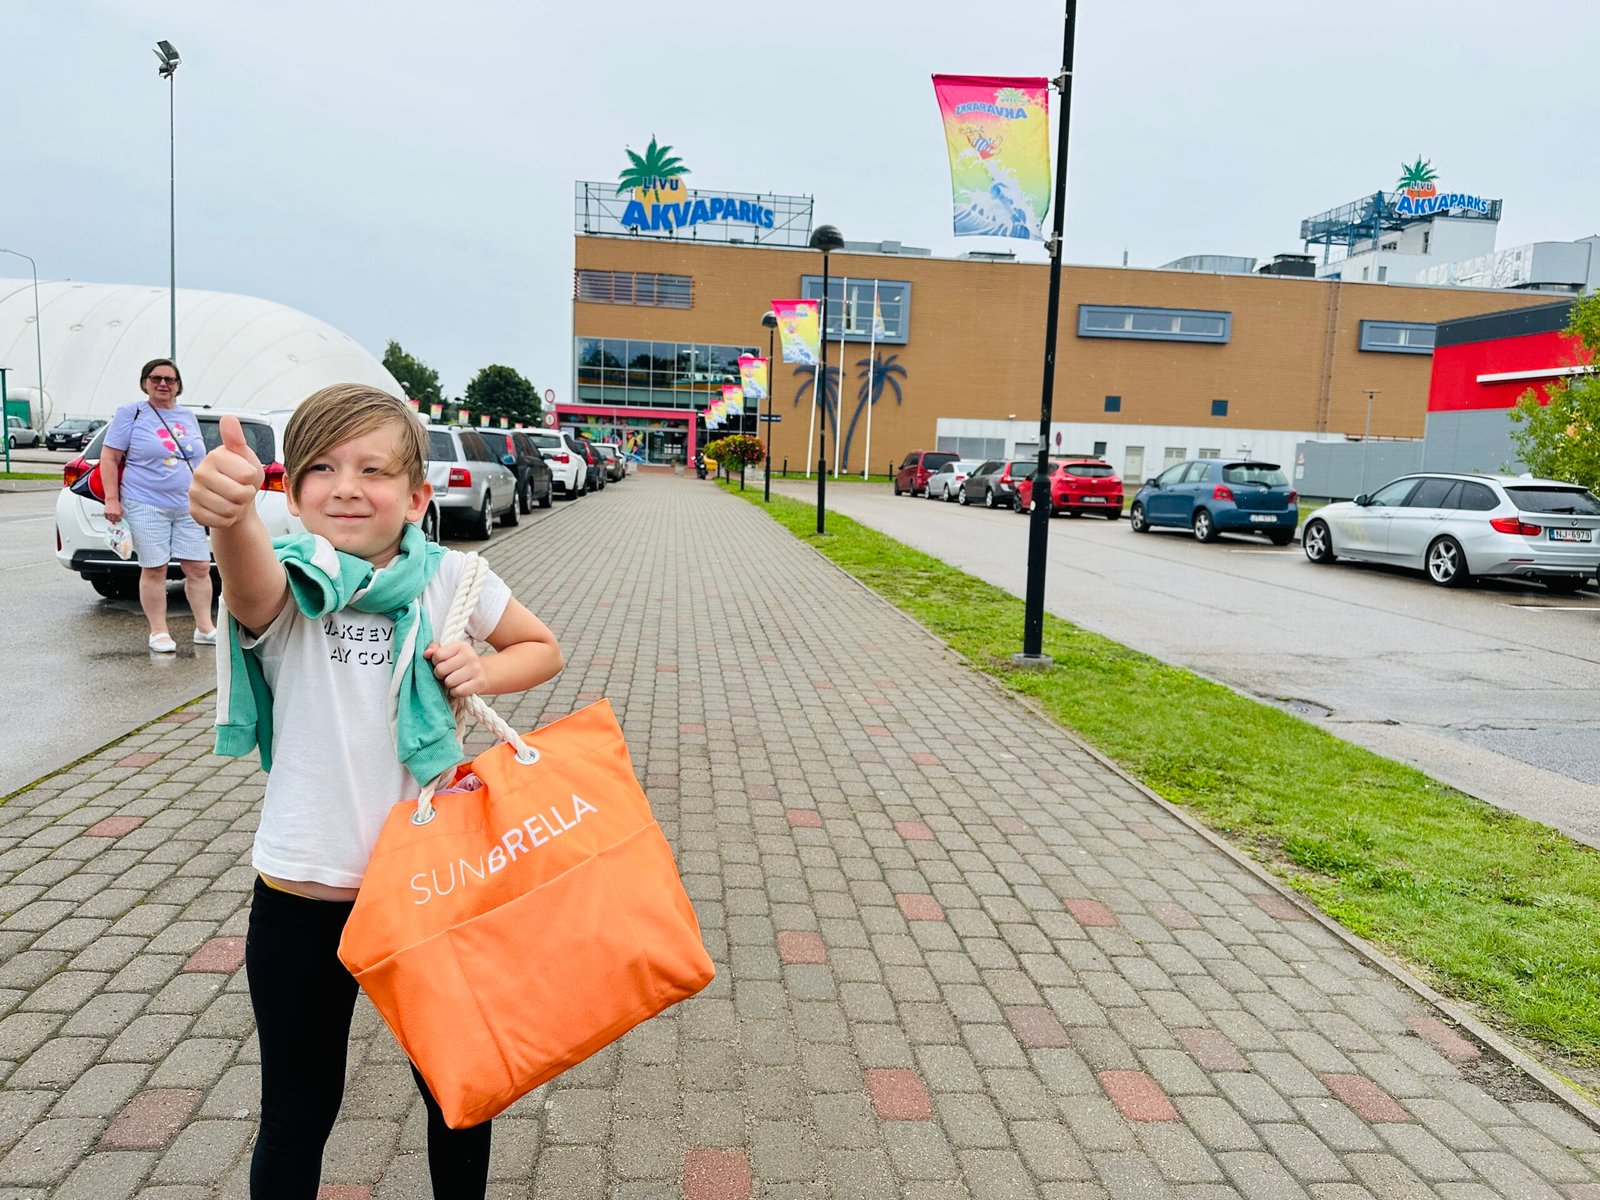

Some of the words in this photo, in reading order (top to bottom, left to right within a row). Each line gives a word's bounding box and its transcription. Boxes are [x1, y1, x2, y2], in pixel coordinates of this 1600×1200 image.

[621, 198, 774, 230] AKVAPARKS
[1397, 193, 1487, 215] AKVAPARKS
[410, 793, 598, 905] SUNBRELLA
